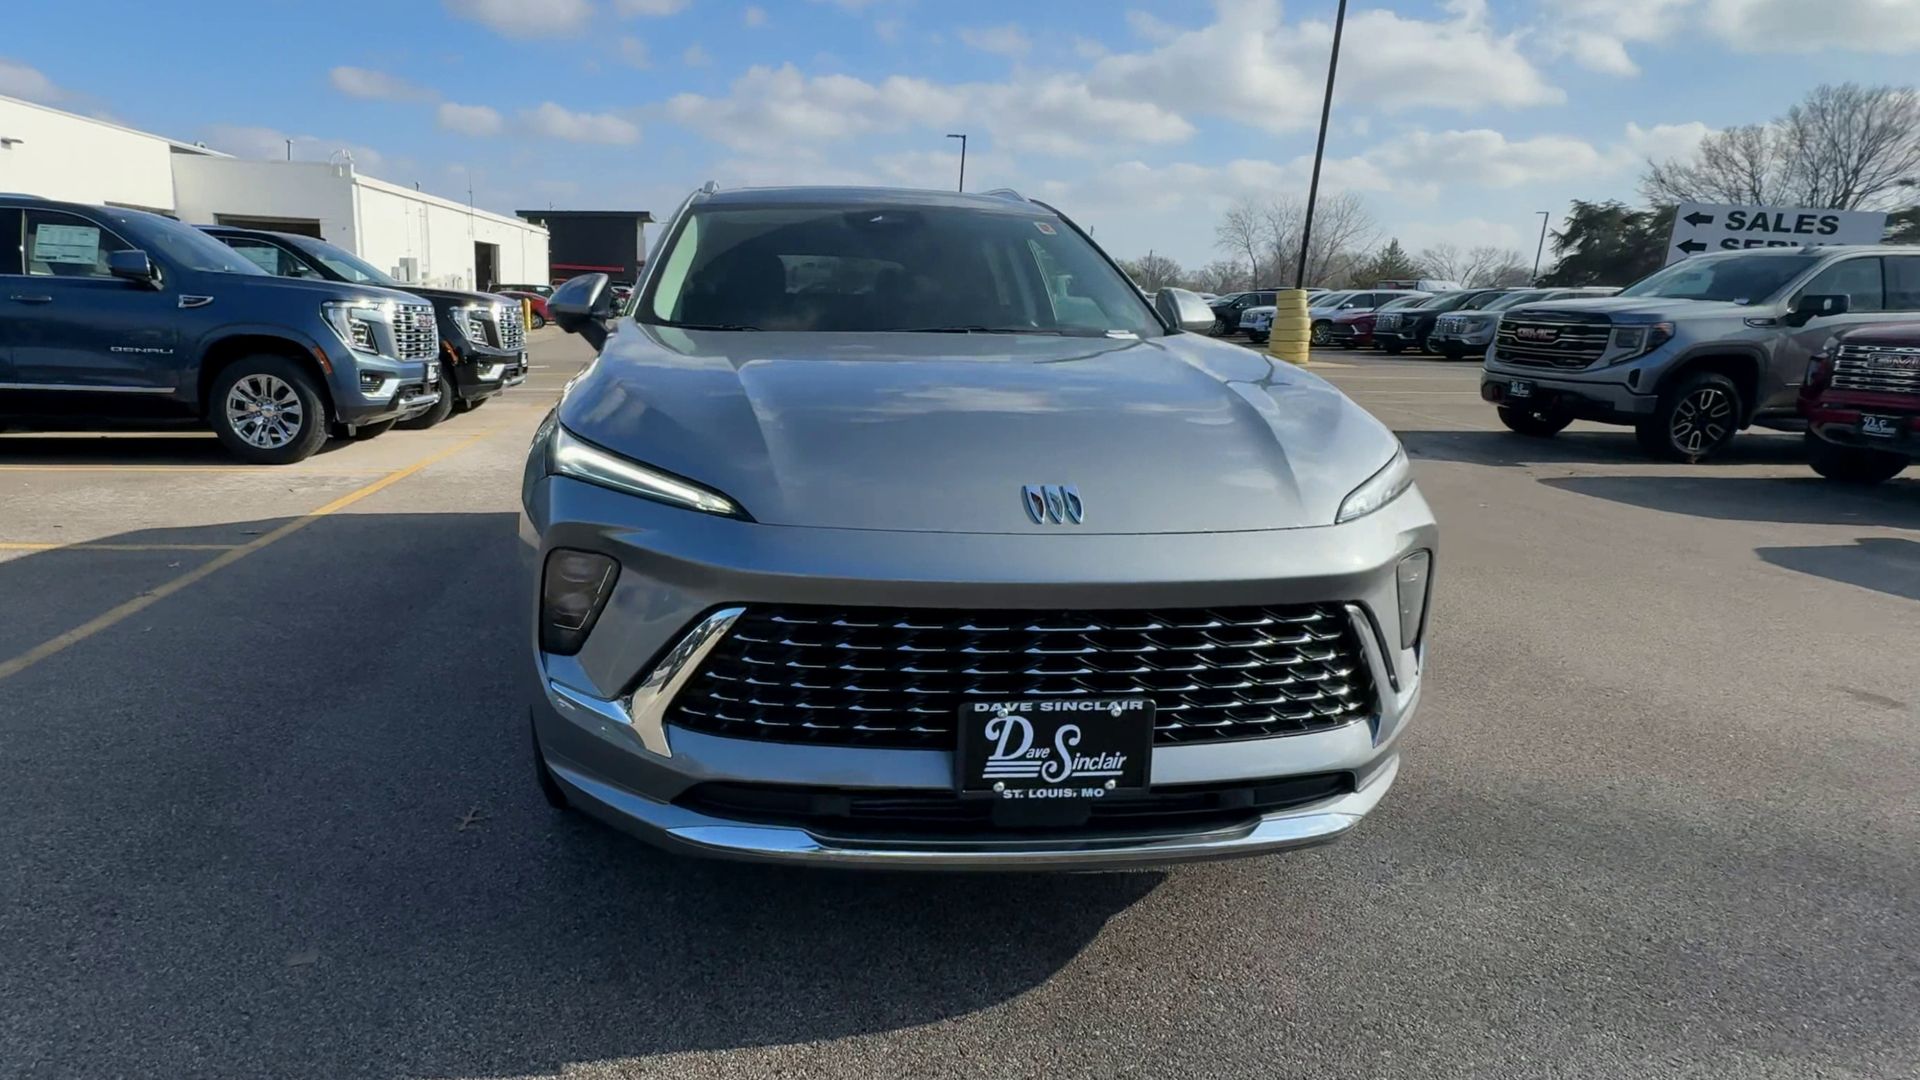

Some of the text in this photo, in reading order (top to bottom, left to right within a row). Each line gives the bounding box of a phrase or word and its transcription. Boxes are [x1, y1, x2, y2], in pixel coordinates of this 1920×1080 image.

[1724, 210, 1840, 236] SALES
[1516, 327, 1558, 339] GMC
[110, 346, 174, 354] DENALI
[974, 700, 1144, 713] DAVE SINCLAIR
[984, 715, 1127, 783] Dave Sinclair
[1003, 789, 1025, 799] ST.
[1081, 788, 1105, 798] MO
